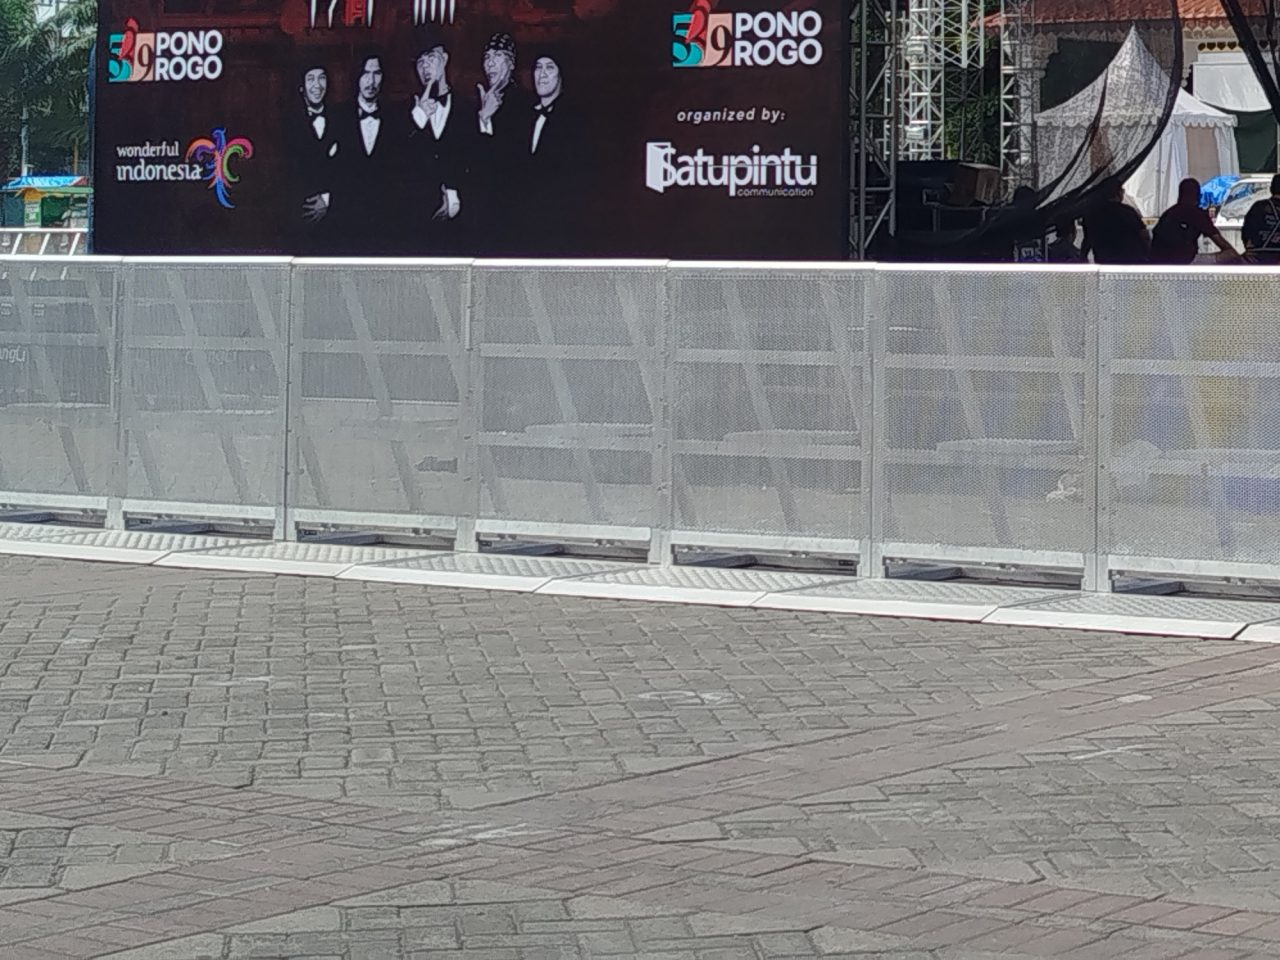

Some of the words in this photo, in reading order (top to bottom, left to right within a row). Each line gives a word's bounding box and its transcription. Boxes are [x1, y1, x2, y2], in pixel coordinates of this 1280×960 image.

[734, 10, 823, 39] PONO
[155, 29, 223, 56] PONO
[733, 38, 824, 67] ROGO
[154, 54, 223, 82] ROGO
[676, 108, 756, 124] organized
[761, 107, 786, 123] by:
[116, 141, 179, 157] wonderful
[116, 159, 203, 181] indonesia
[660, 145, 818, 197] Satupintu
[736, 187, 814, 197] communication
